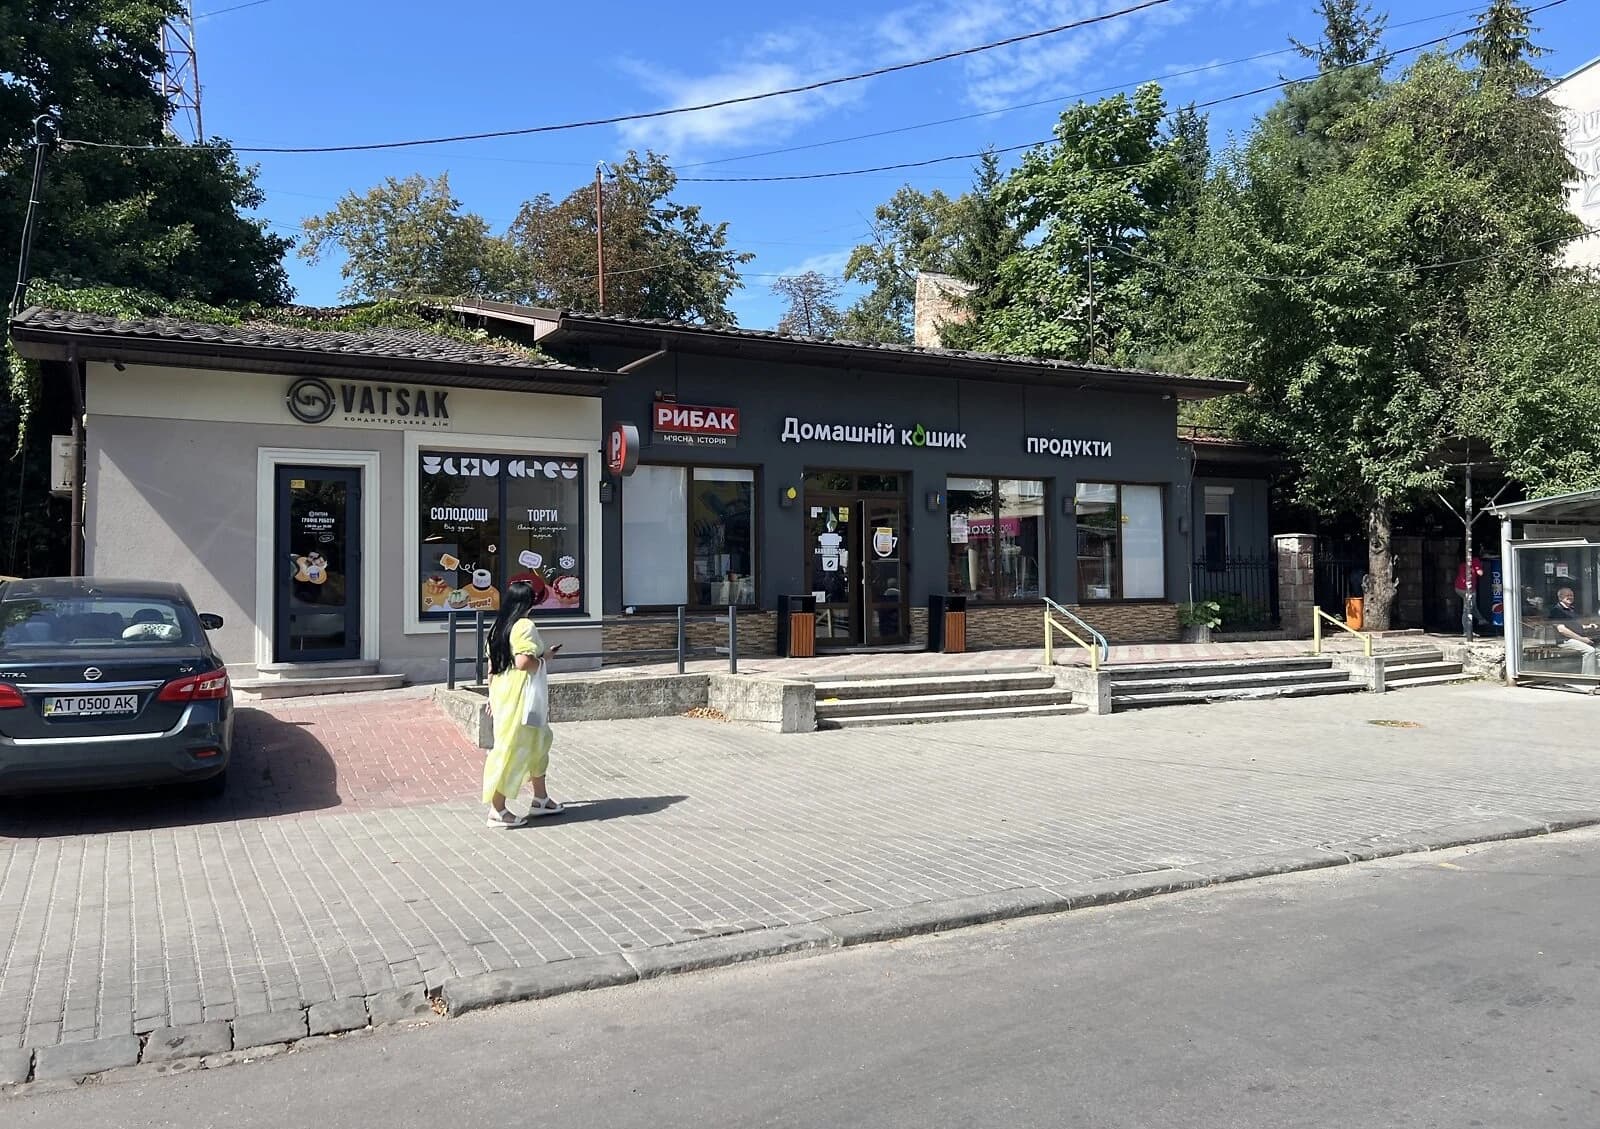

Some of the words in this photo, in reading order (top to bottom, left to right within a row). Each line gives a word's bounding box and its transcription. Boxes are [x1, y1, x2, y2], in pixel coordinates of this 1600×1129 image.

[341, 384, 449, 419] VATSAK
[344, 417, 427, 426] кондитерський
[657, 408, 735, 430] РИБАК
[663, 434, 694, 444] М'ЯСНА
[697, 436, 727, 445] ІСТОРІЯ
[781, 416, 896, 445] Домашній
[901, 423, 967, 449] кошик
[1027, 436, 1113, 458] ПРОДУКТИ
[430, 506, 488, 522] СОЛОДОЩІ
[527, 509, 558, 522] ТОРТИ
[53, 699, 75, 711] AT
[78, 697, 109, 710] 0500
[114, 696, 135, 709] AK
